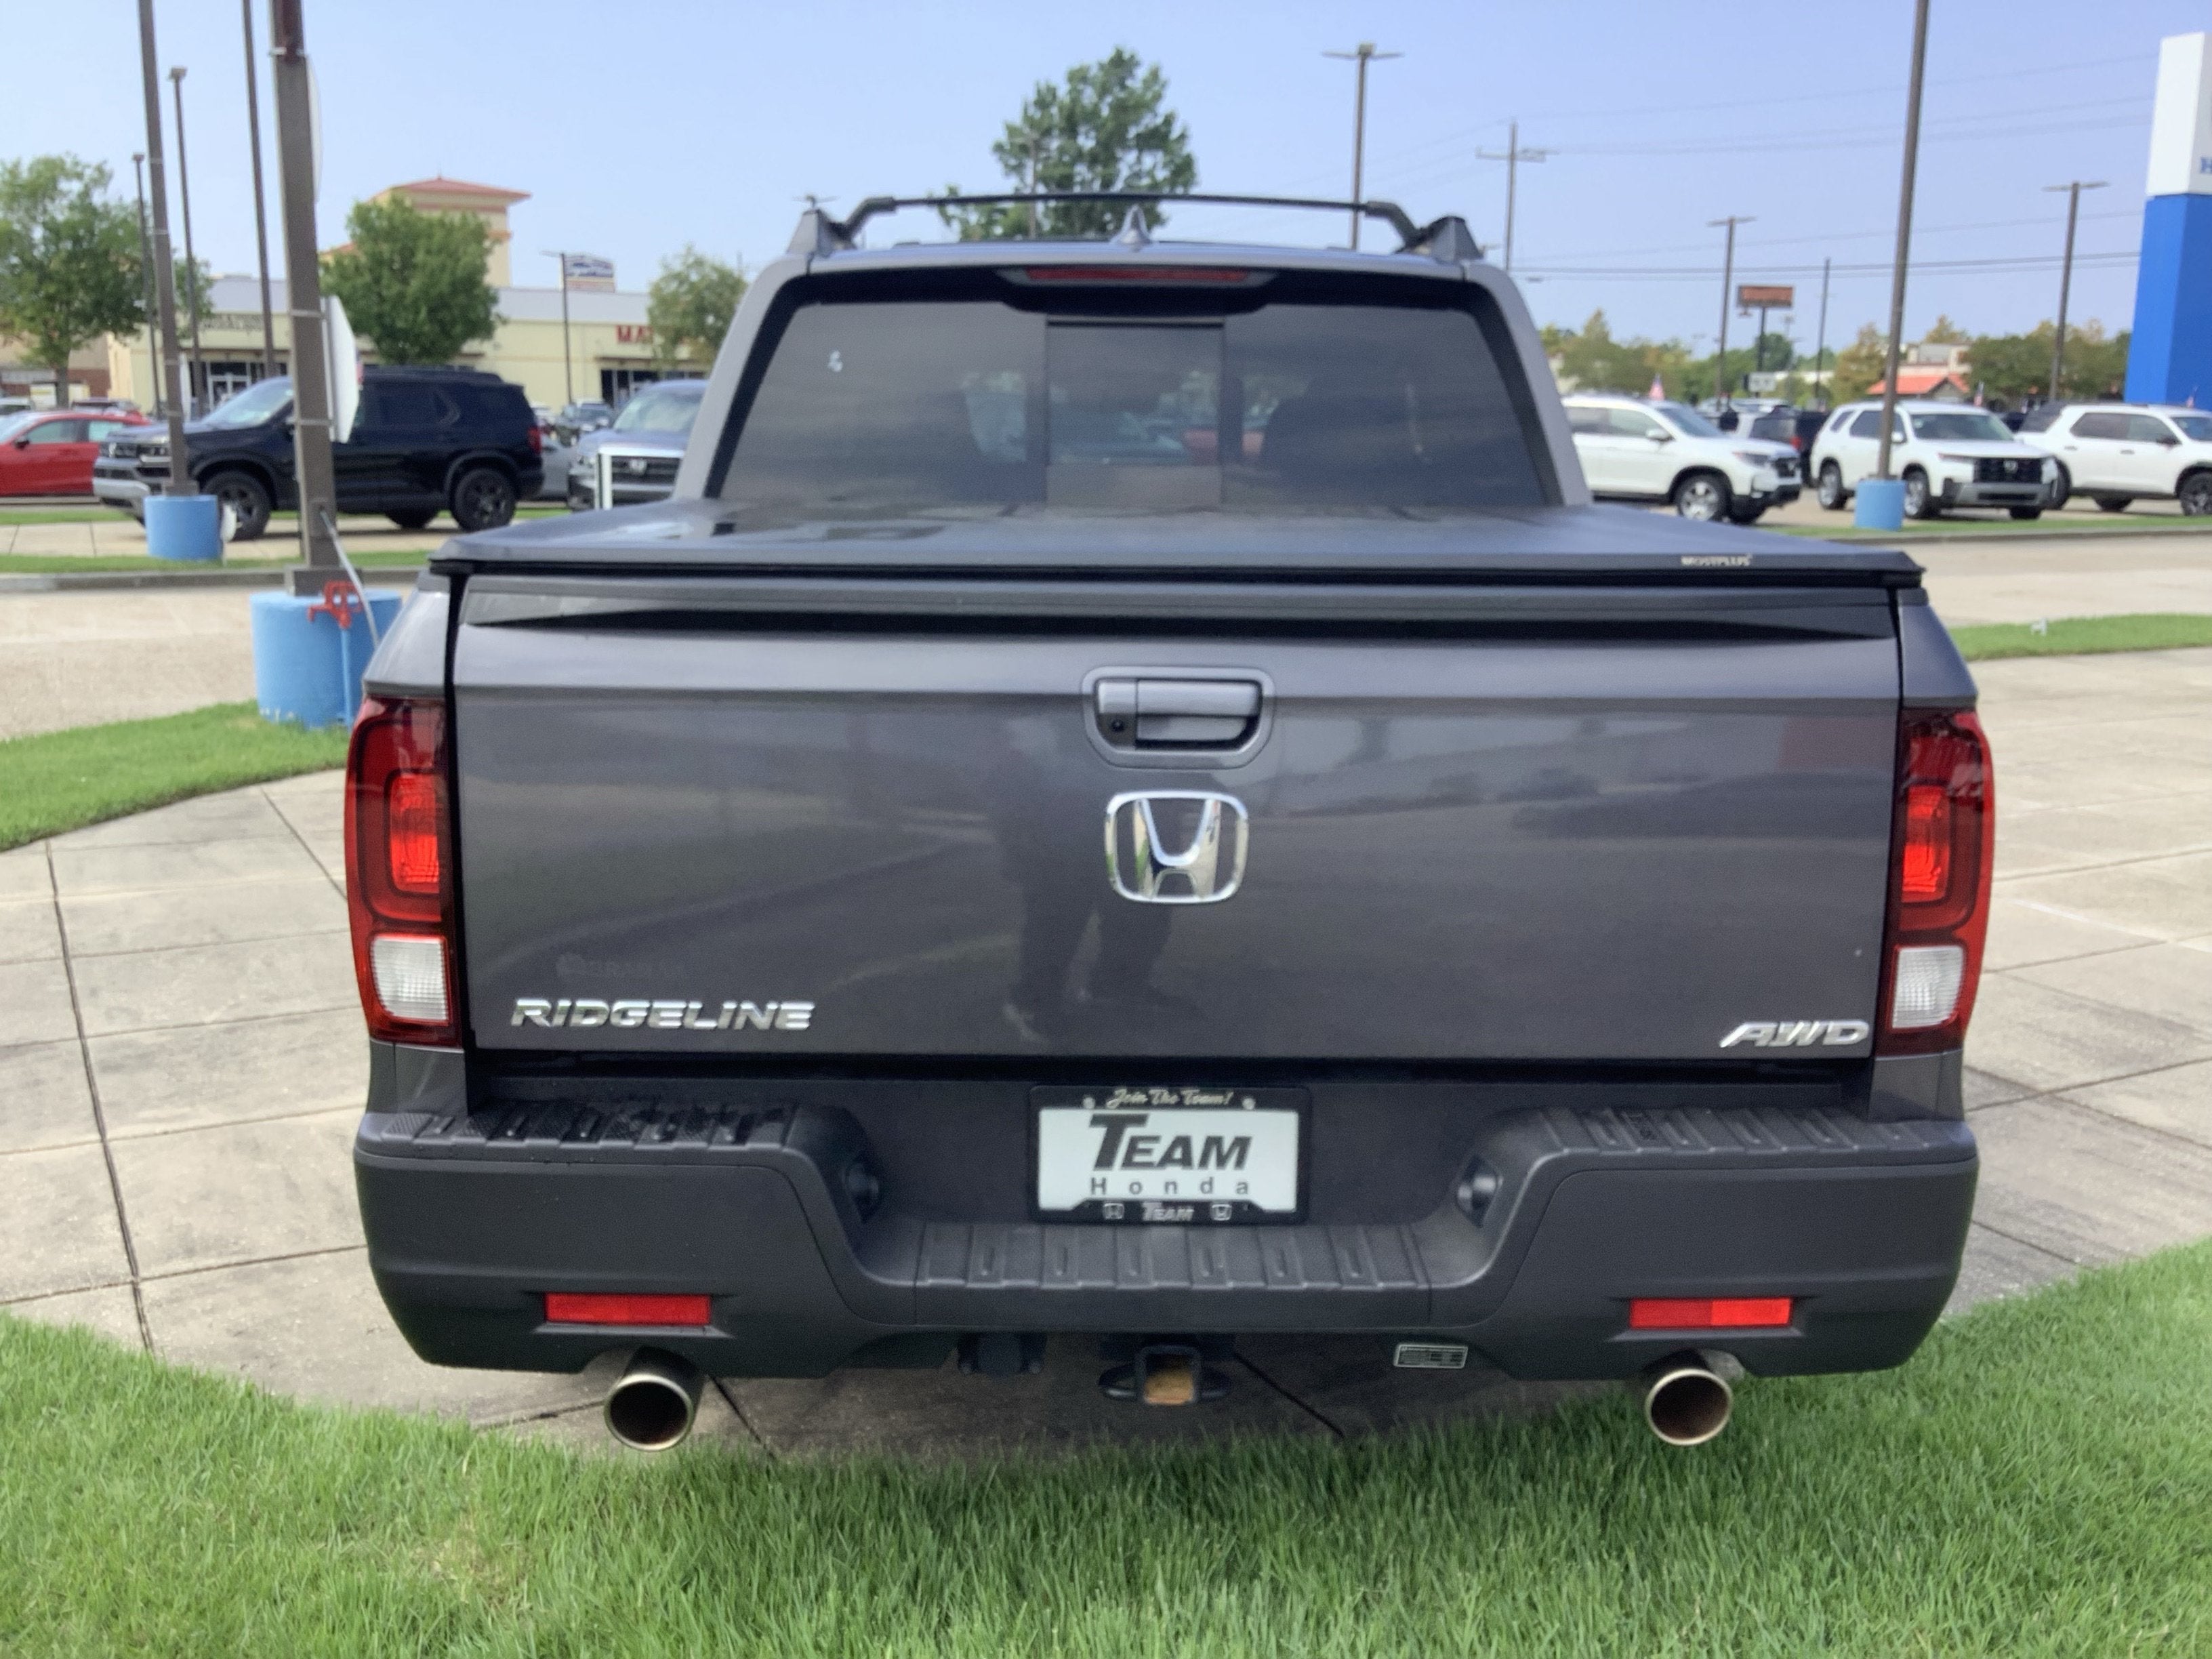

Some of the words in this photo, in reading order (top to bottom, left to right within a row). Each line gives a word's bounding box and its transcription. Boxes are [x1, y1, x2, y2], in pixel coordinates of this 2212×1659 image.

[511, 998, 815, 1031] RIDGELINE
[1719, 1019, 1870, 1048] AWD
[1106, 1088, 1148, 1109] Join
[1148, 1088, 1180, 1105] The
[1090, 1176, 1250, 1195] Honda
